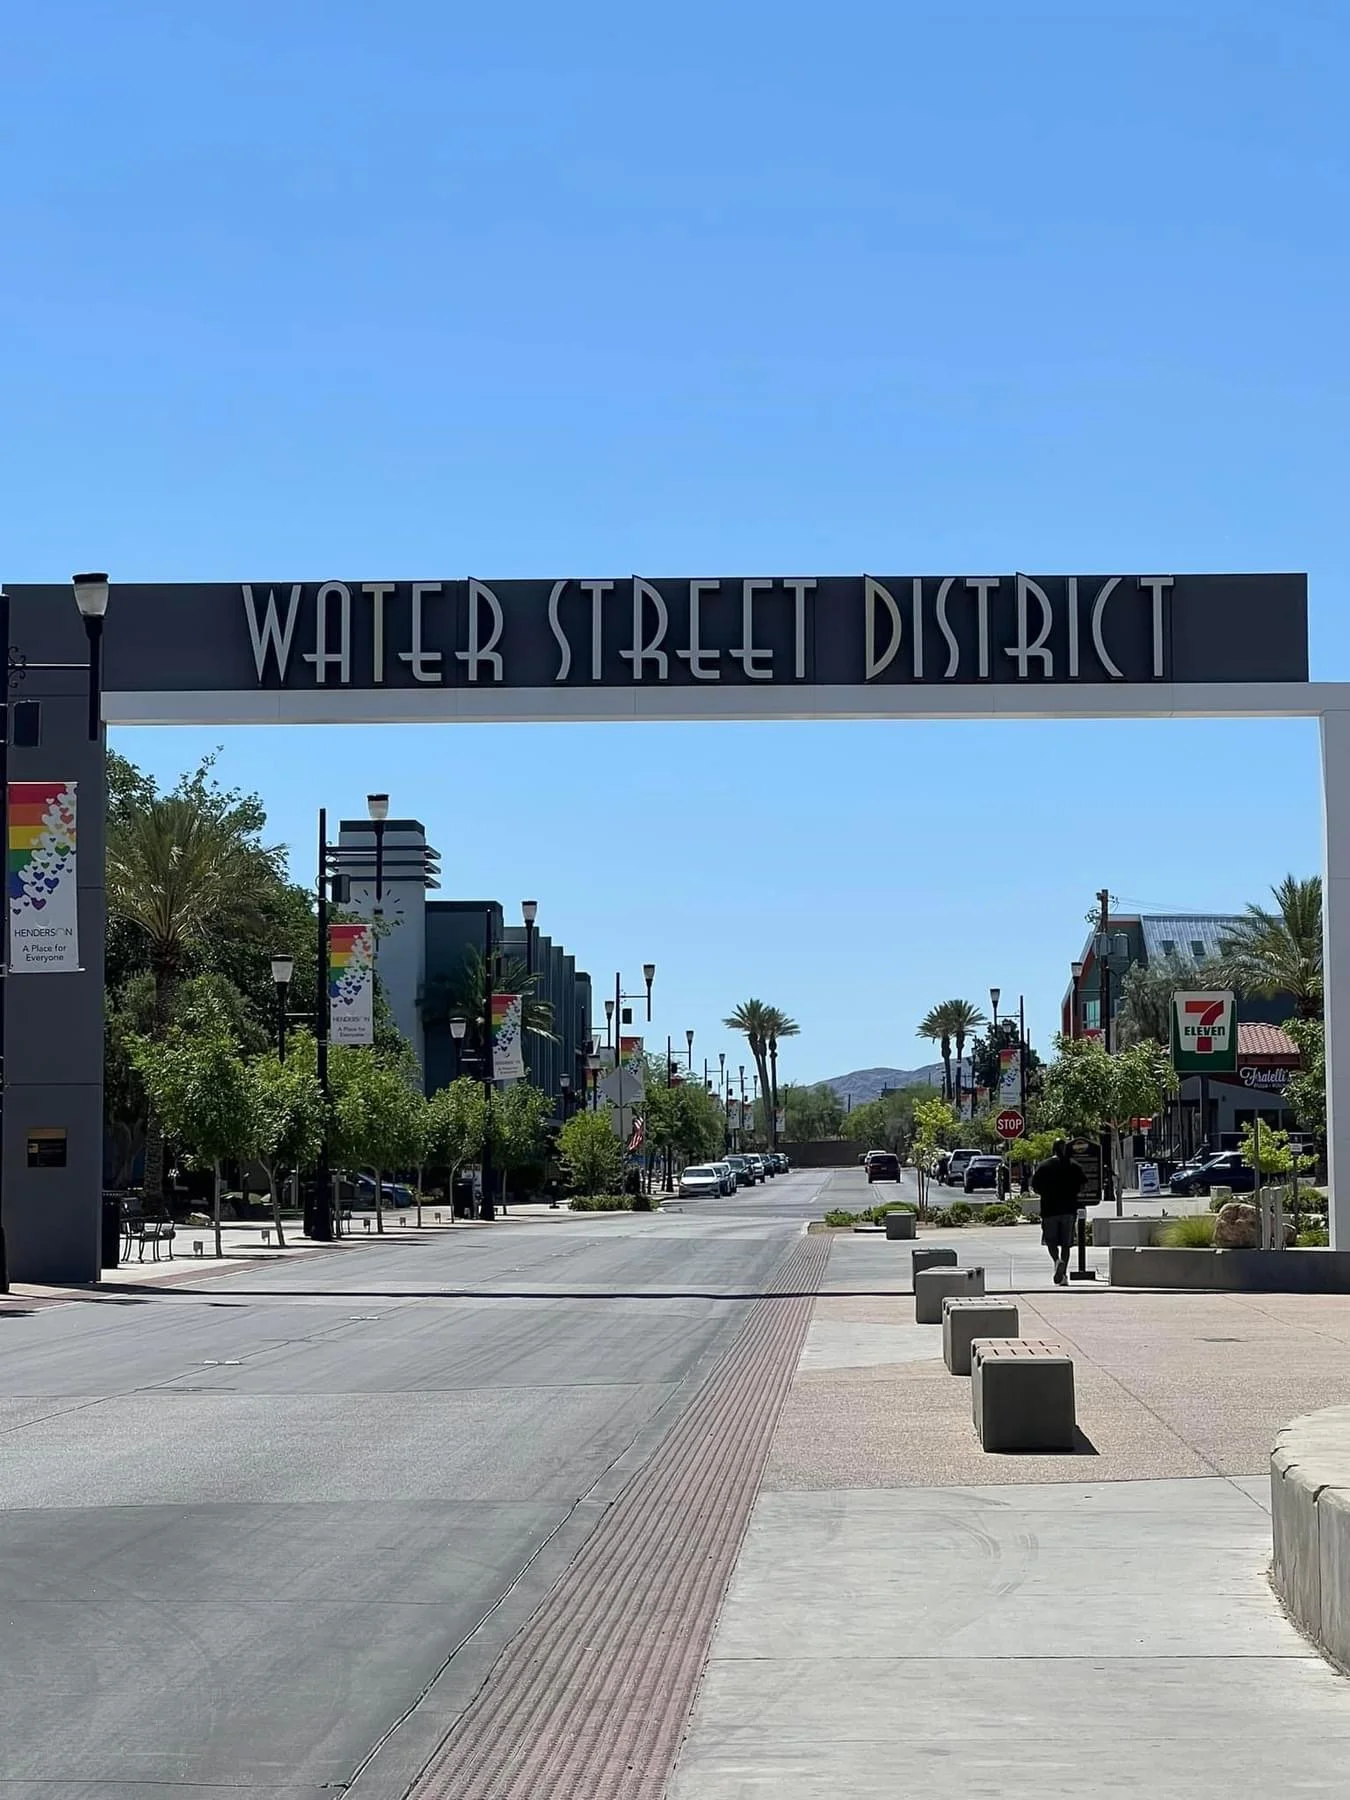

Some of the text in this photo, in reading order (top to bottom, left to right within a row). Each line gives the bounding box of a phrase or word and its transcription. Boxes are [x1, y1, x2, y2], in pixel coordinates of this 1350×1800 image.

[241, 574, 1175, 684] WATER STREET DISTRICT
[31, 944, 53, 953] Place
[55, 943, 67, 952] for
[25, 953, 64, 963] Everyone
[1184, 1000, 1224, 1052] 7
[997, 1119, 1022, 1130] STOP
